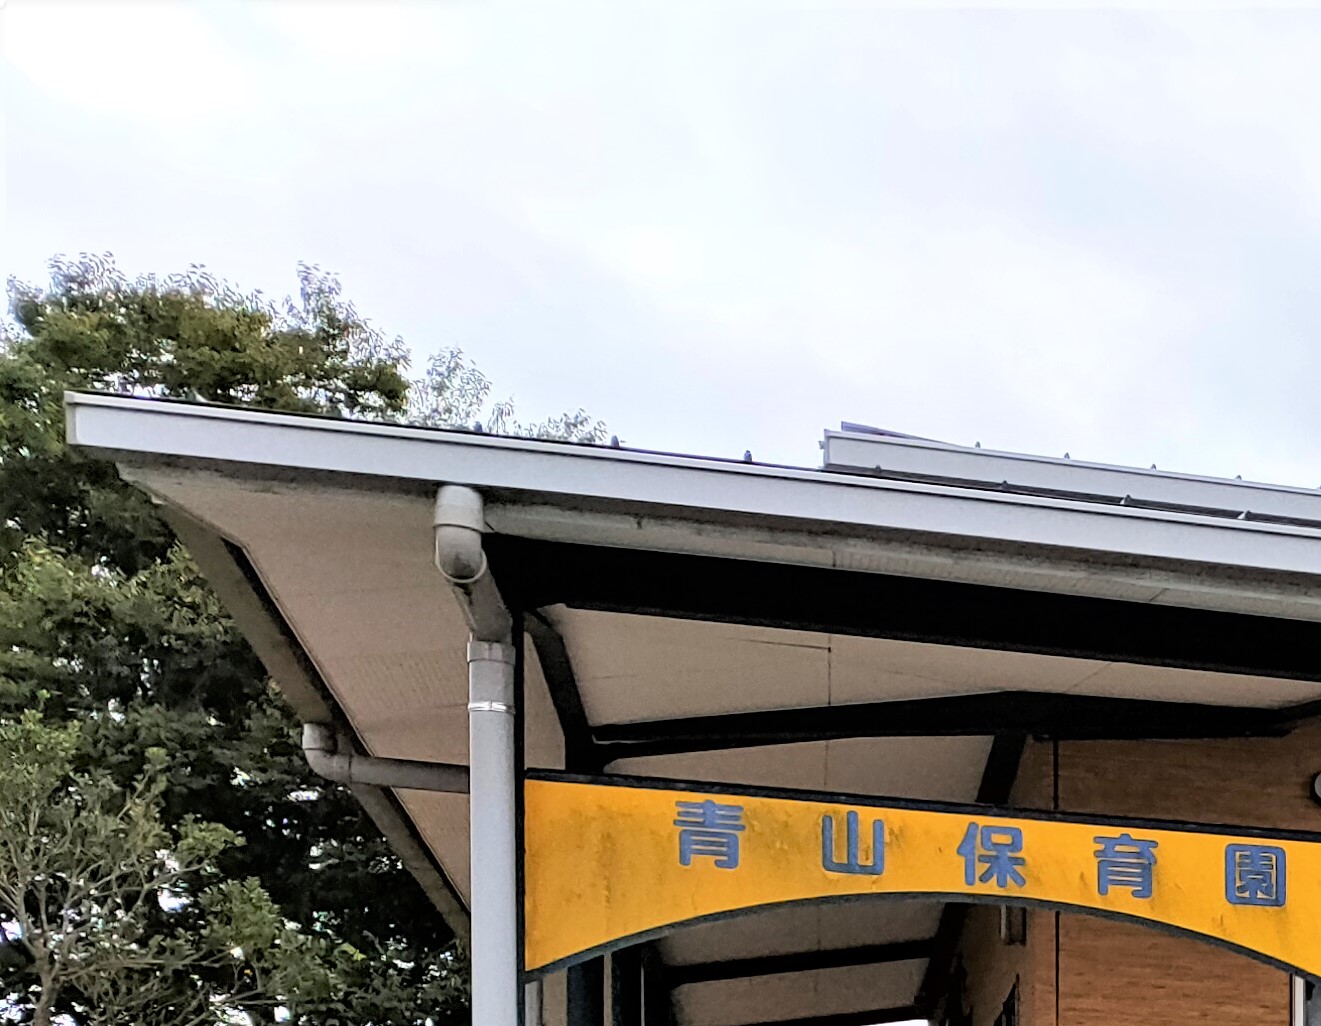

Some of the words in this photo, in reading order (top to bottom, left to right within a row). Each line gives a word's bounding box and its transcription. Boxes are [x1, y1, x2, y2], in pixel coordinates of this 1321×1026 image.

[673, 800, 1287, 907] 青山保育園
